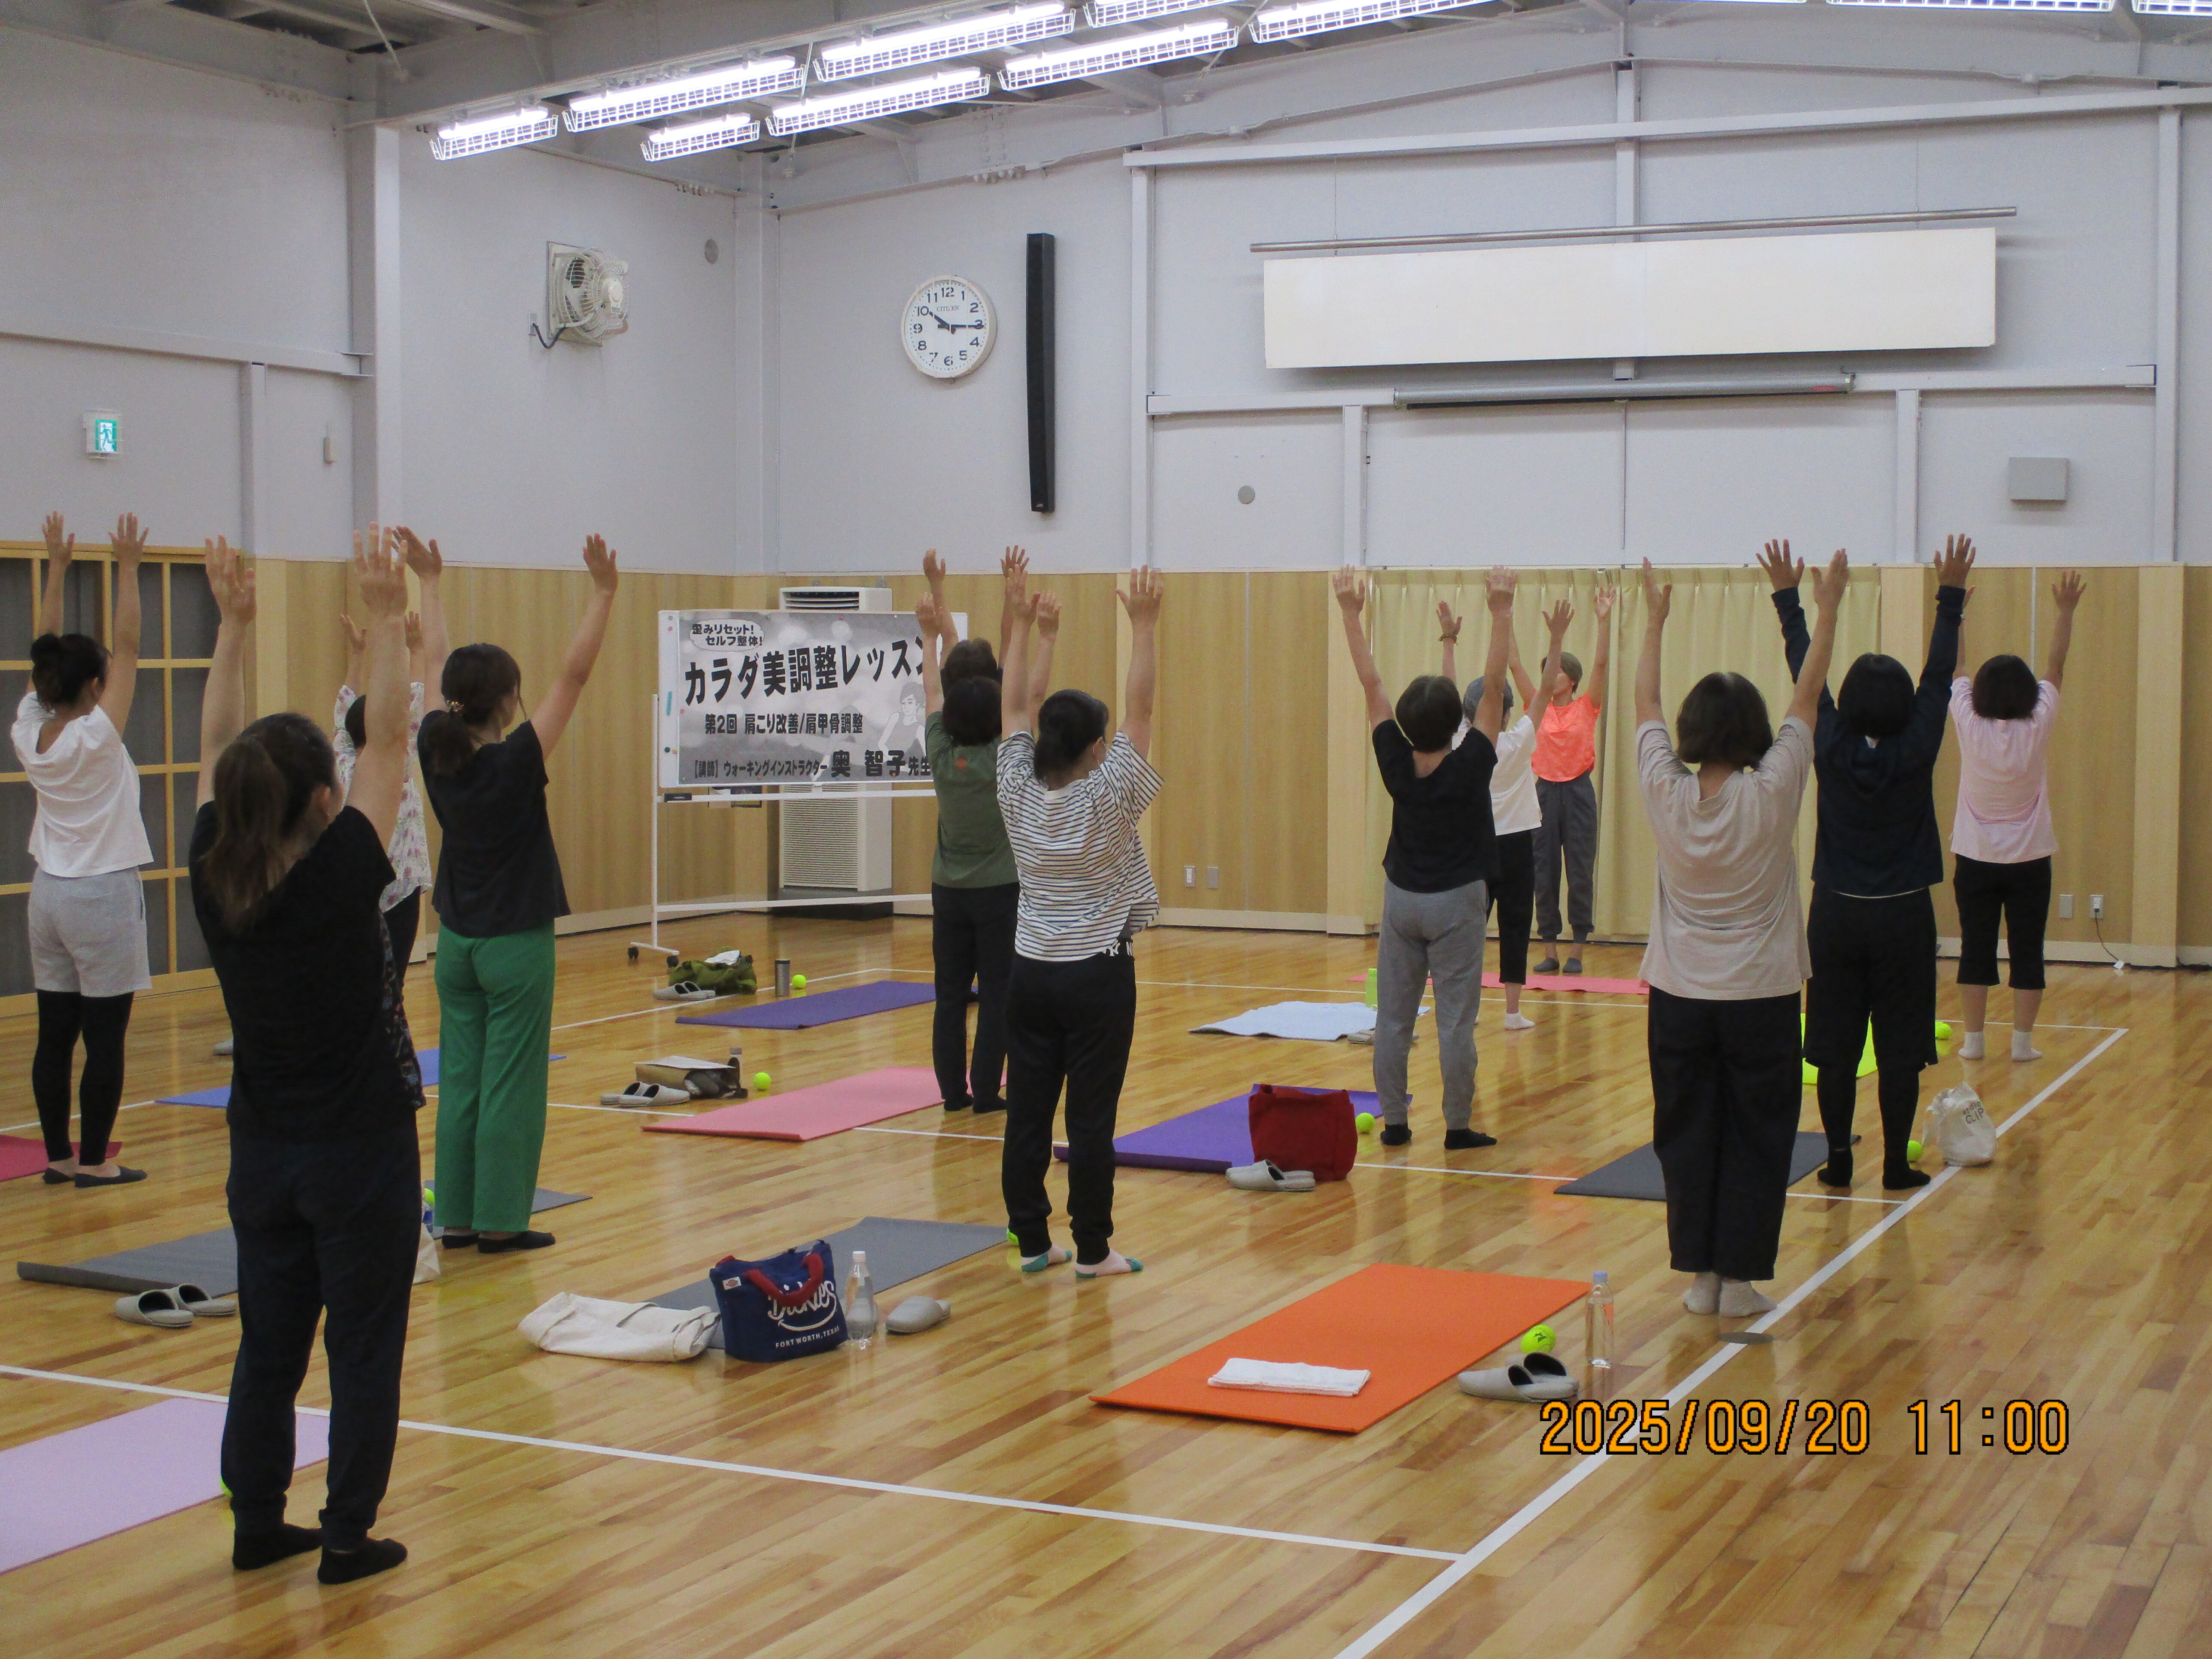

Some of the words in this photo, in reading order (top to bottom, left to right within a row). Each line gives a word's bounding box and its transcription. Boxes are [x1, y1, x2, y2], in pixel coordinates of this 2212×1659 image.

[927, 292, 938, 303] 11
[941, 287, 954, 298] 12
[961, 291, 965, 301] 1
[917, 306, 930, 316] 10
[969, 302, 979, 313] 2
[913, 323, 923, 334] 9
[974, 319, 983, 330] 3
[918, 340, 927, 350] 8
[969, 337, 980, 347] 4
[929, 352, 938, 362] 7
[944, 356, 953, 366] 6
[959, 350, 967, 361] 5
[692, 623, 754, 635] 歪みリセット!
[705, 635, 763, 646] セルフ整体!
[705, 713, 737, 735] 第2回
[744, 713, 863, 735] 肩こり改善/肩甲骨調整
[831, 749, 851, 778] 奥
[775, 1339, 794, 1349] FORT
